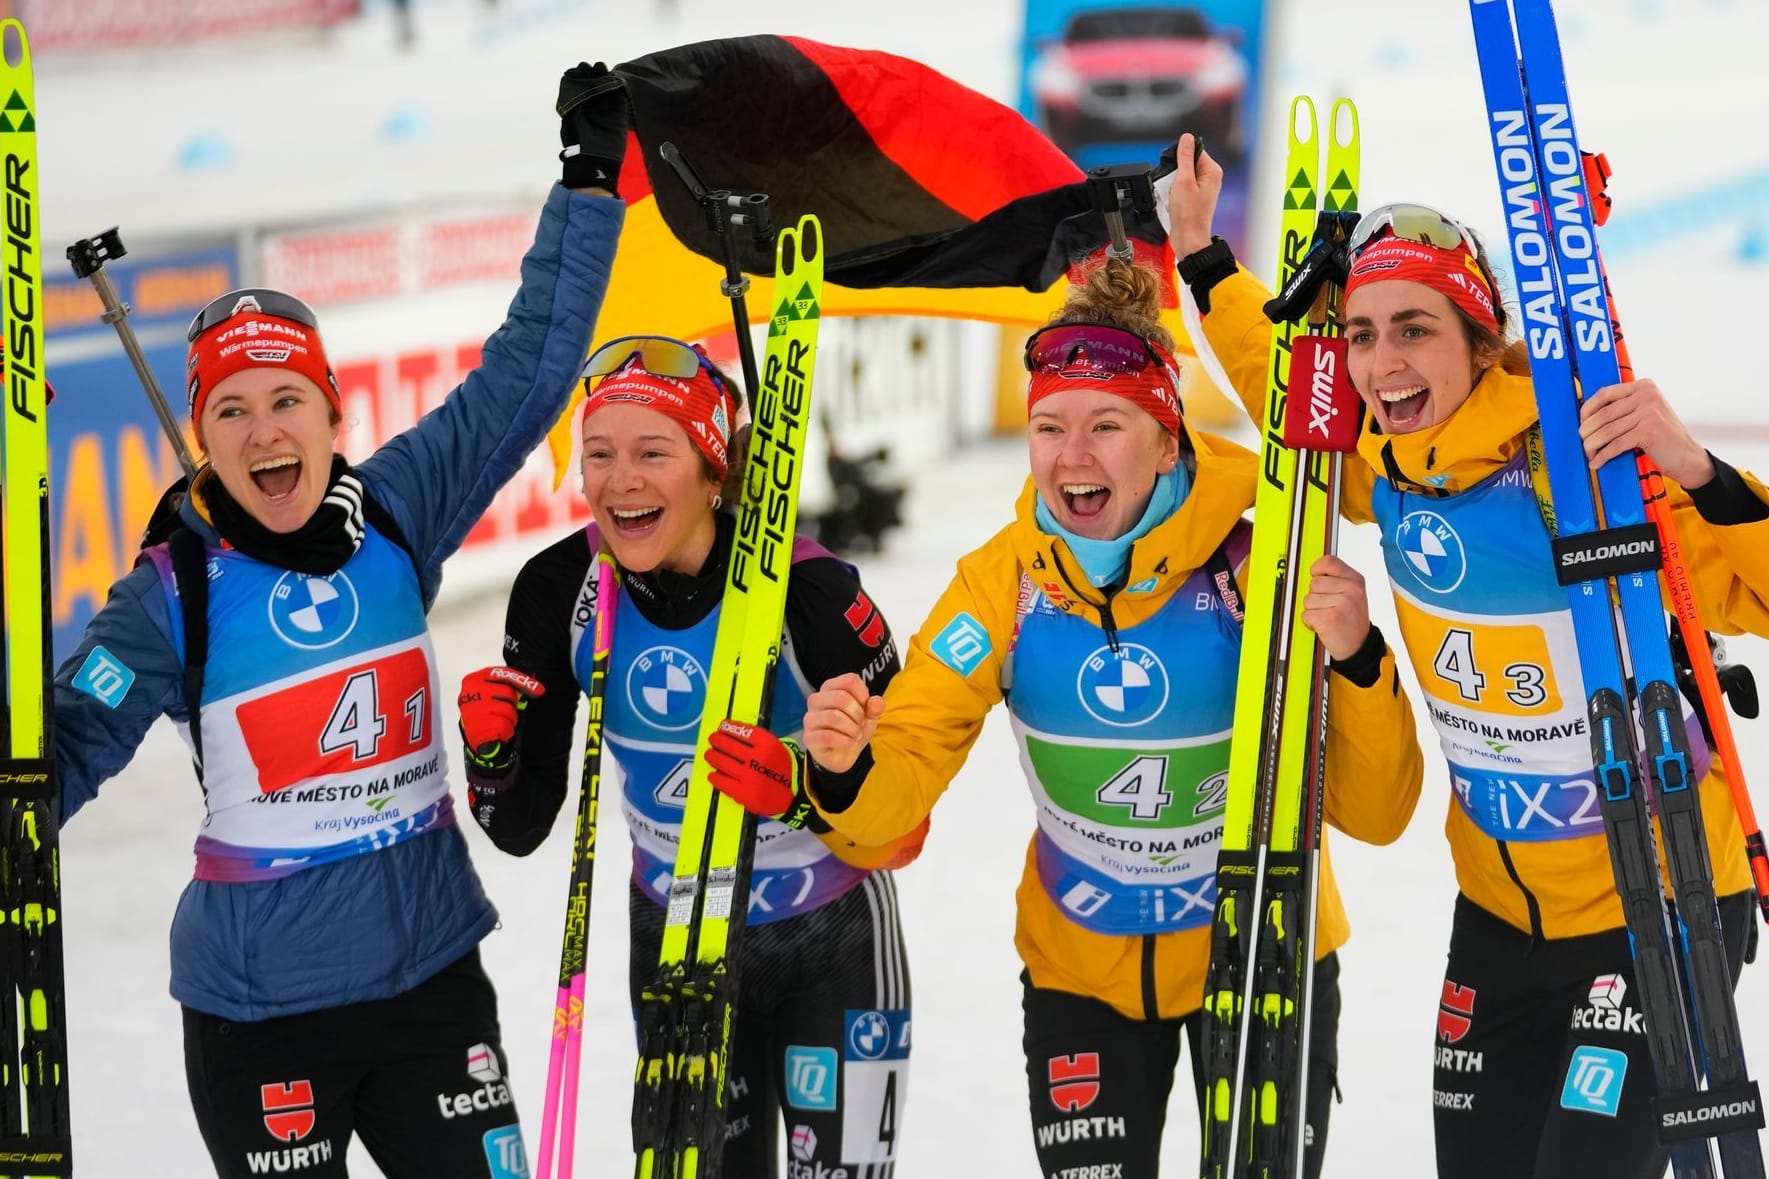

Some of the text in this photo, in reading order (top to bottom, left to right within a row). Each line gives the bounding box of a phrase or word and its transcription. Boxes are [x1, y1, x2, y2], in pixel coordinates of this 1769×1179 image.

[1493, 111, 1564, 359] SALOMON
[1536, 104, 1611, 352] SALOMON
[5, 153, 37, 424] FISCHER
[219, 339, 308, 358] Wärmepumpen
[731, 353, 783, 594] FISCHER
[760, 338, 810, 583] FISCHER
[1493, 469, 1533, 489] MW
[1401, 514, 1453, 543] BMW
[1561, 540, 1656, 567] SALOMON
[638, 650, 699, 677] BMW
[947, 620, 984, 671] TQ
[1089, 647, 1156, 673] BMW
[1433, 628, 1547, 708] 4 3
[89, 655, 124, 703] TQ
[318, 667, 426, 762] 4 1
[1435, 710, 1586, 743] MĚSTO NA MORAVĚ
[251, 786, 294, 804] OVÉ
[367, 777, 391, 796] NA
[1096, 754, 1174, 822] 4
[1193, 770, 1230, 817] 2
[1498, 778, 1604, 831] iX2
[315, 815, 342, 832] Kraj
[1148, 839, 1177, 855] NA
[791, 1055, 827, 1104] TQ
[1574, 1054, 1616, 1107] TQ
[878, 1069, 897, 1157] 4
[1037, 1115, 1127, 1149] WÜRTH
[1661, 1099, 1757, 1128] SALOMON
[245, 1137, 333, 1175] WÜRTH
